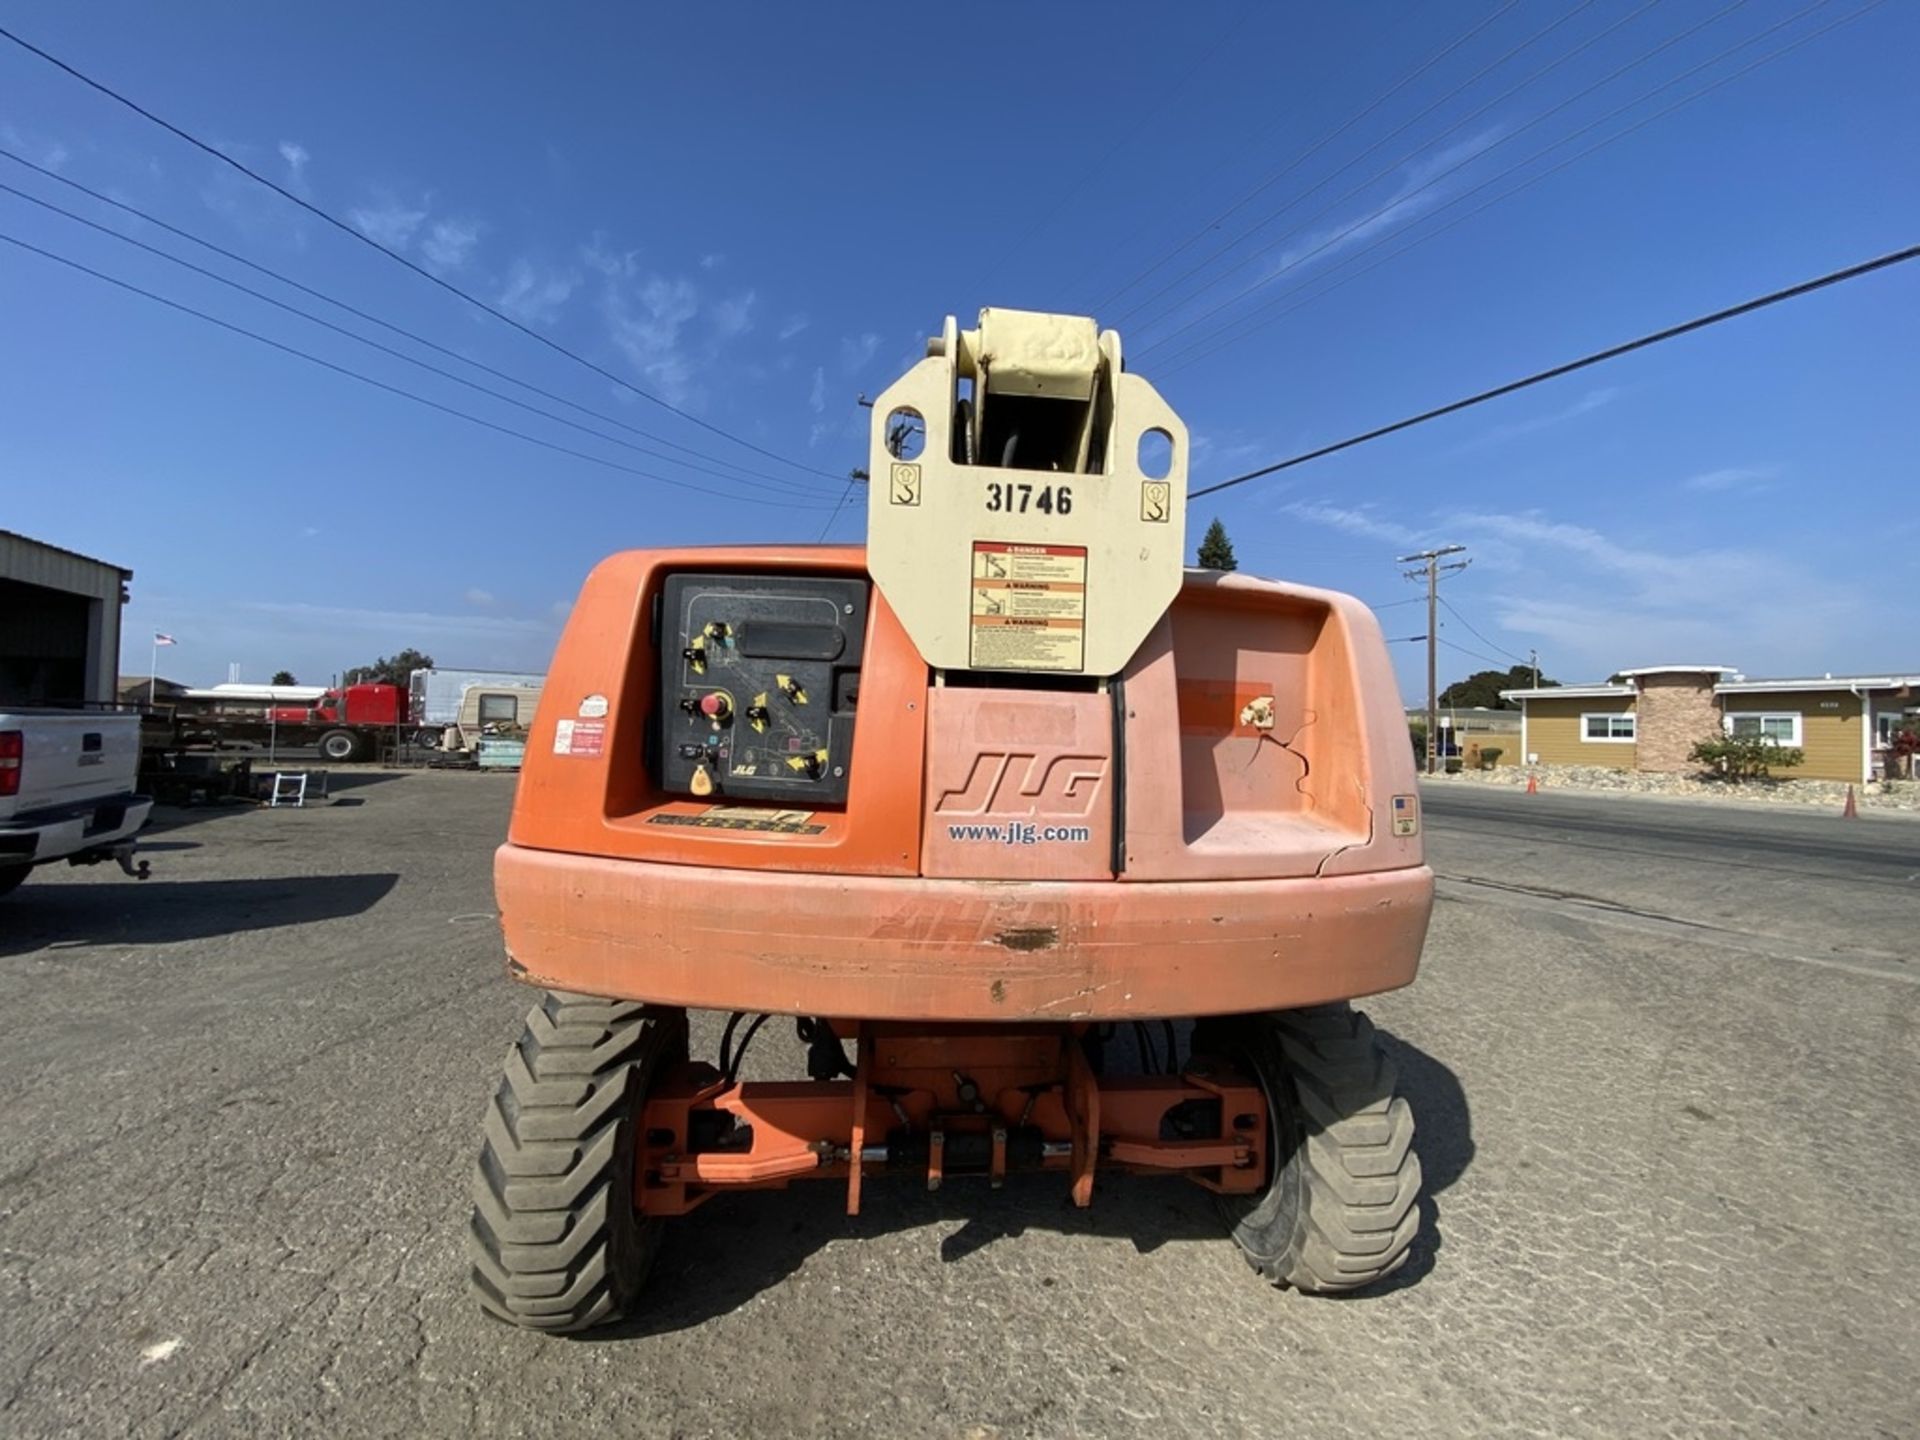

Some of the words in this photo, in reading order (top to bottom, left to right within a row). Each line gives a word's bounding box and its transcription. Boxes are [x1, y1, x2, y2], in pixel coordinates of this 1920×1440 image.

[986, 483, 1072, 515] 31746
[1013, 582, 1050, 590] WARNING
[1012, 619, 1049, 627] WARNING
[732, 764, 757, 776] JLG
[935, 752, 1108, 818] JLG
[949, 822, 1089, 845] www.jlg.com
